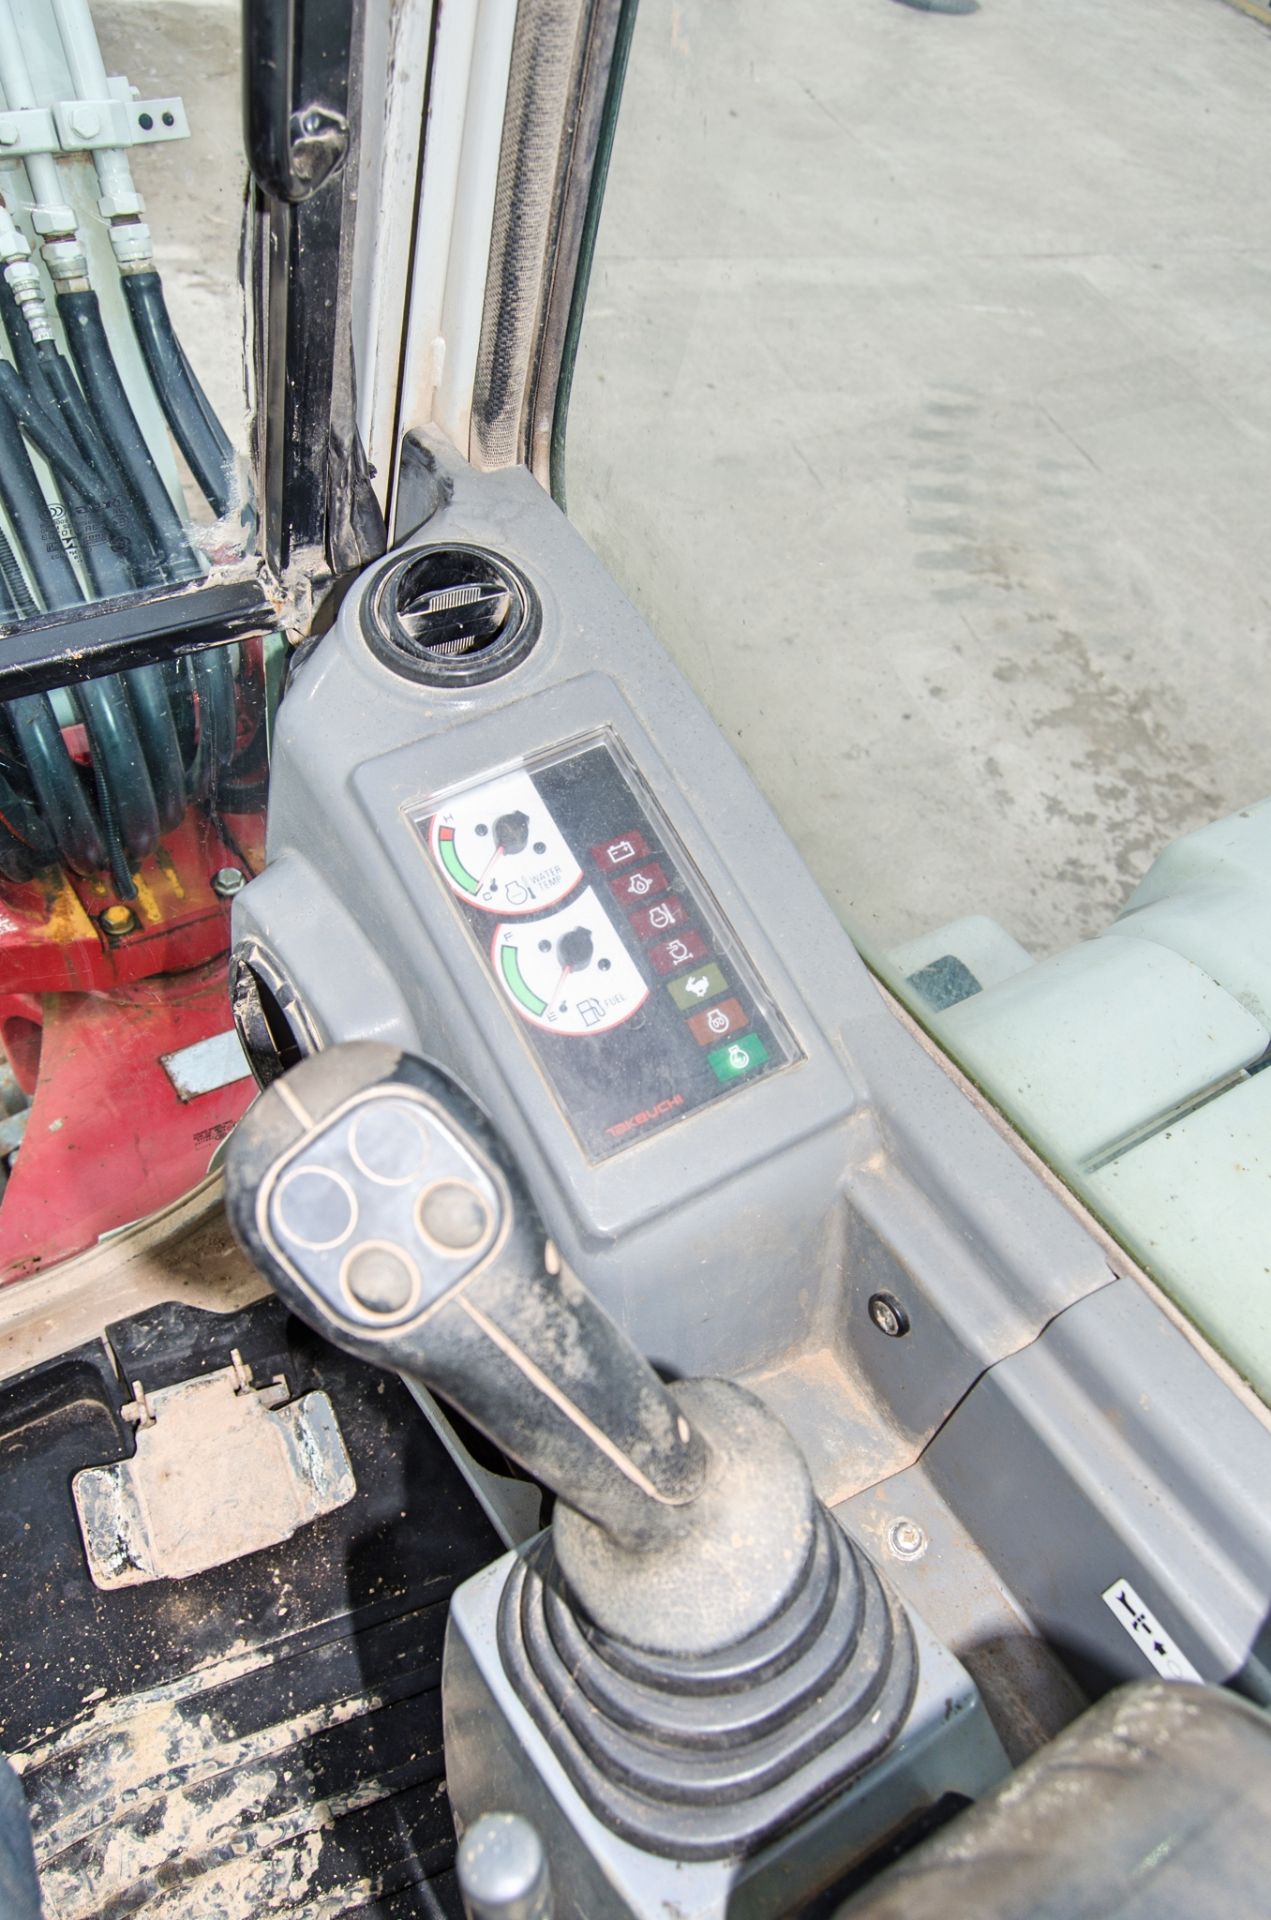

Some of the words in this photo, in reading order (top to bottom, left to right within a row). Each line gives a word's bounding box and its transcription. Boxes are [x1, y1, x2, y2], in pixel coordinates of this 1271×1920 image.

[530, 864, 561, 885] WATER
[539, 875, 561, 890] TEMP
[482, 891, 493, 902] C
[503, 931, 513, 943] F
[604, 994, 626, 1009] FUEL
[546, 1011, 558, 1022] E
[604, 1093, 685, 1137] TAKEUCHI
